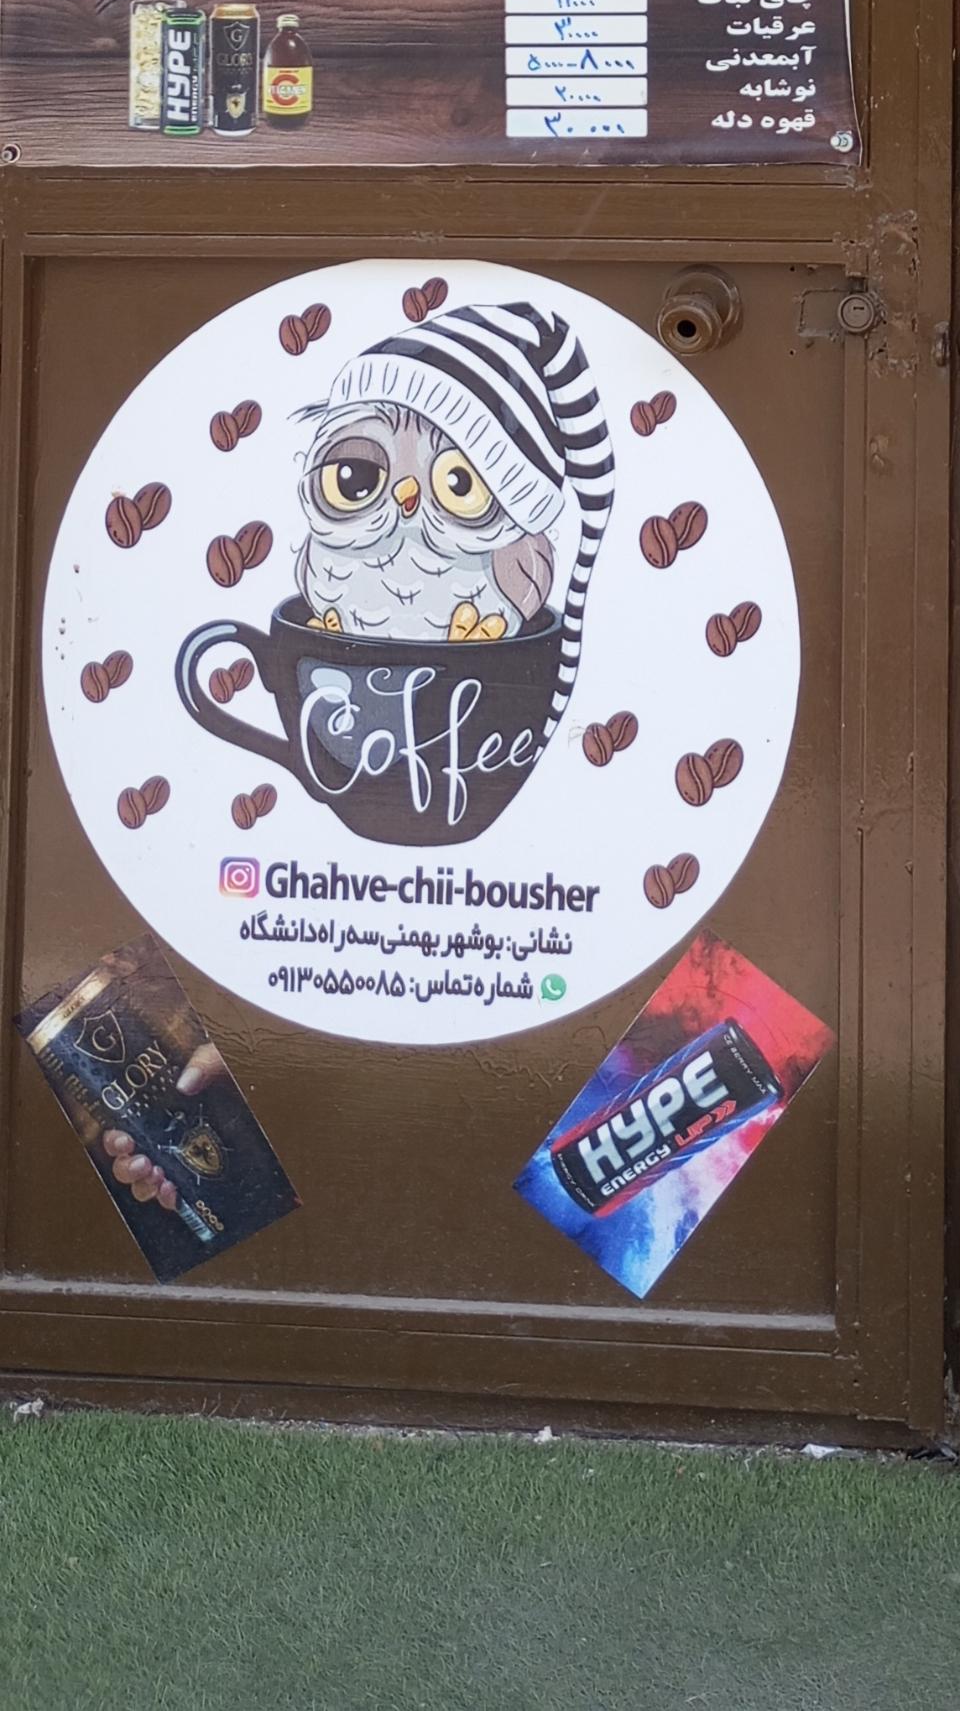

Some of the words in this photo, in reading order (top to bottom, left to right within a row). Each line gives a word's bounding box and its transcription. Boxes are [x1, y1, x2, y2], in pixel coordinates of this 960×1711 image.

[726, 15, 816, 40] عرقیات
[167, 29, 191, 122] HYPE
[739, 78, 816, 102] نوشابه
[711, 110, 753, 128] دله
[760, 109, 816, 134] قهوه
[300, 667, 535, 825] Coffee
[265, 860, 600, 913] Ghahve-chii-bousher
[443, 923, 505, 961] بوشهر
[506, 926, 572, 961] نشانی:
[91, 1026, 117, 1053] G
[101, 1040, 170, 1112] GLORY
[578, 1051, 729, 1186] HYPE
[600, 1145, 671, 1196] ENERGY
